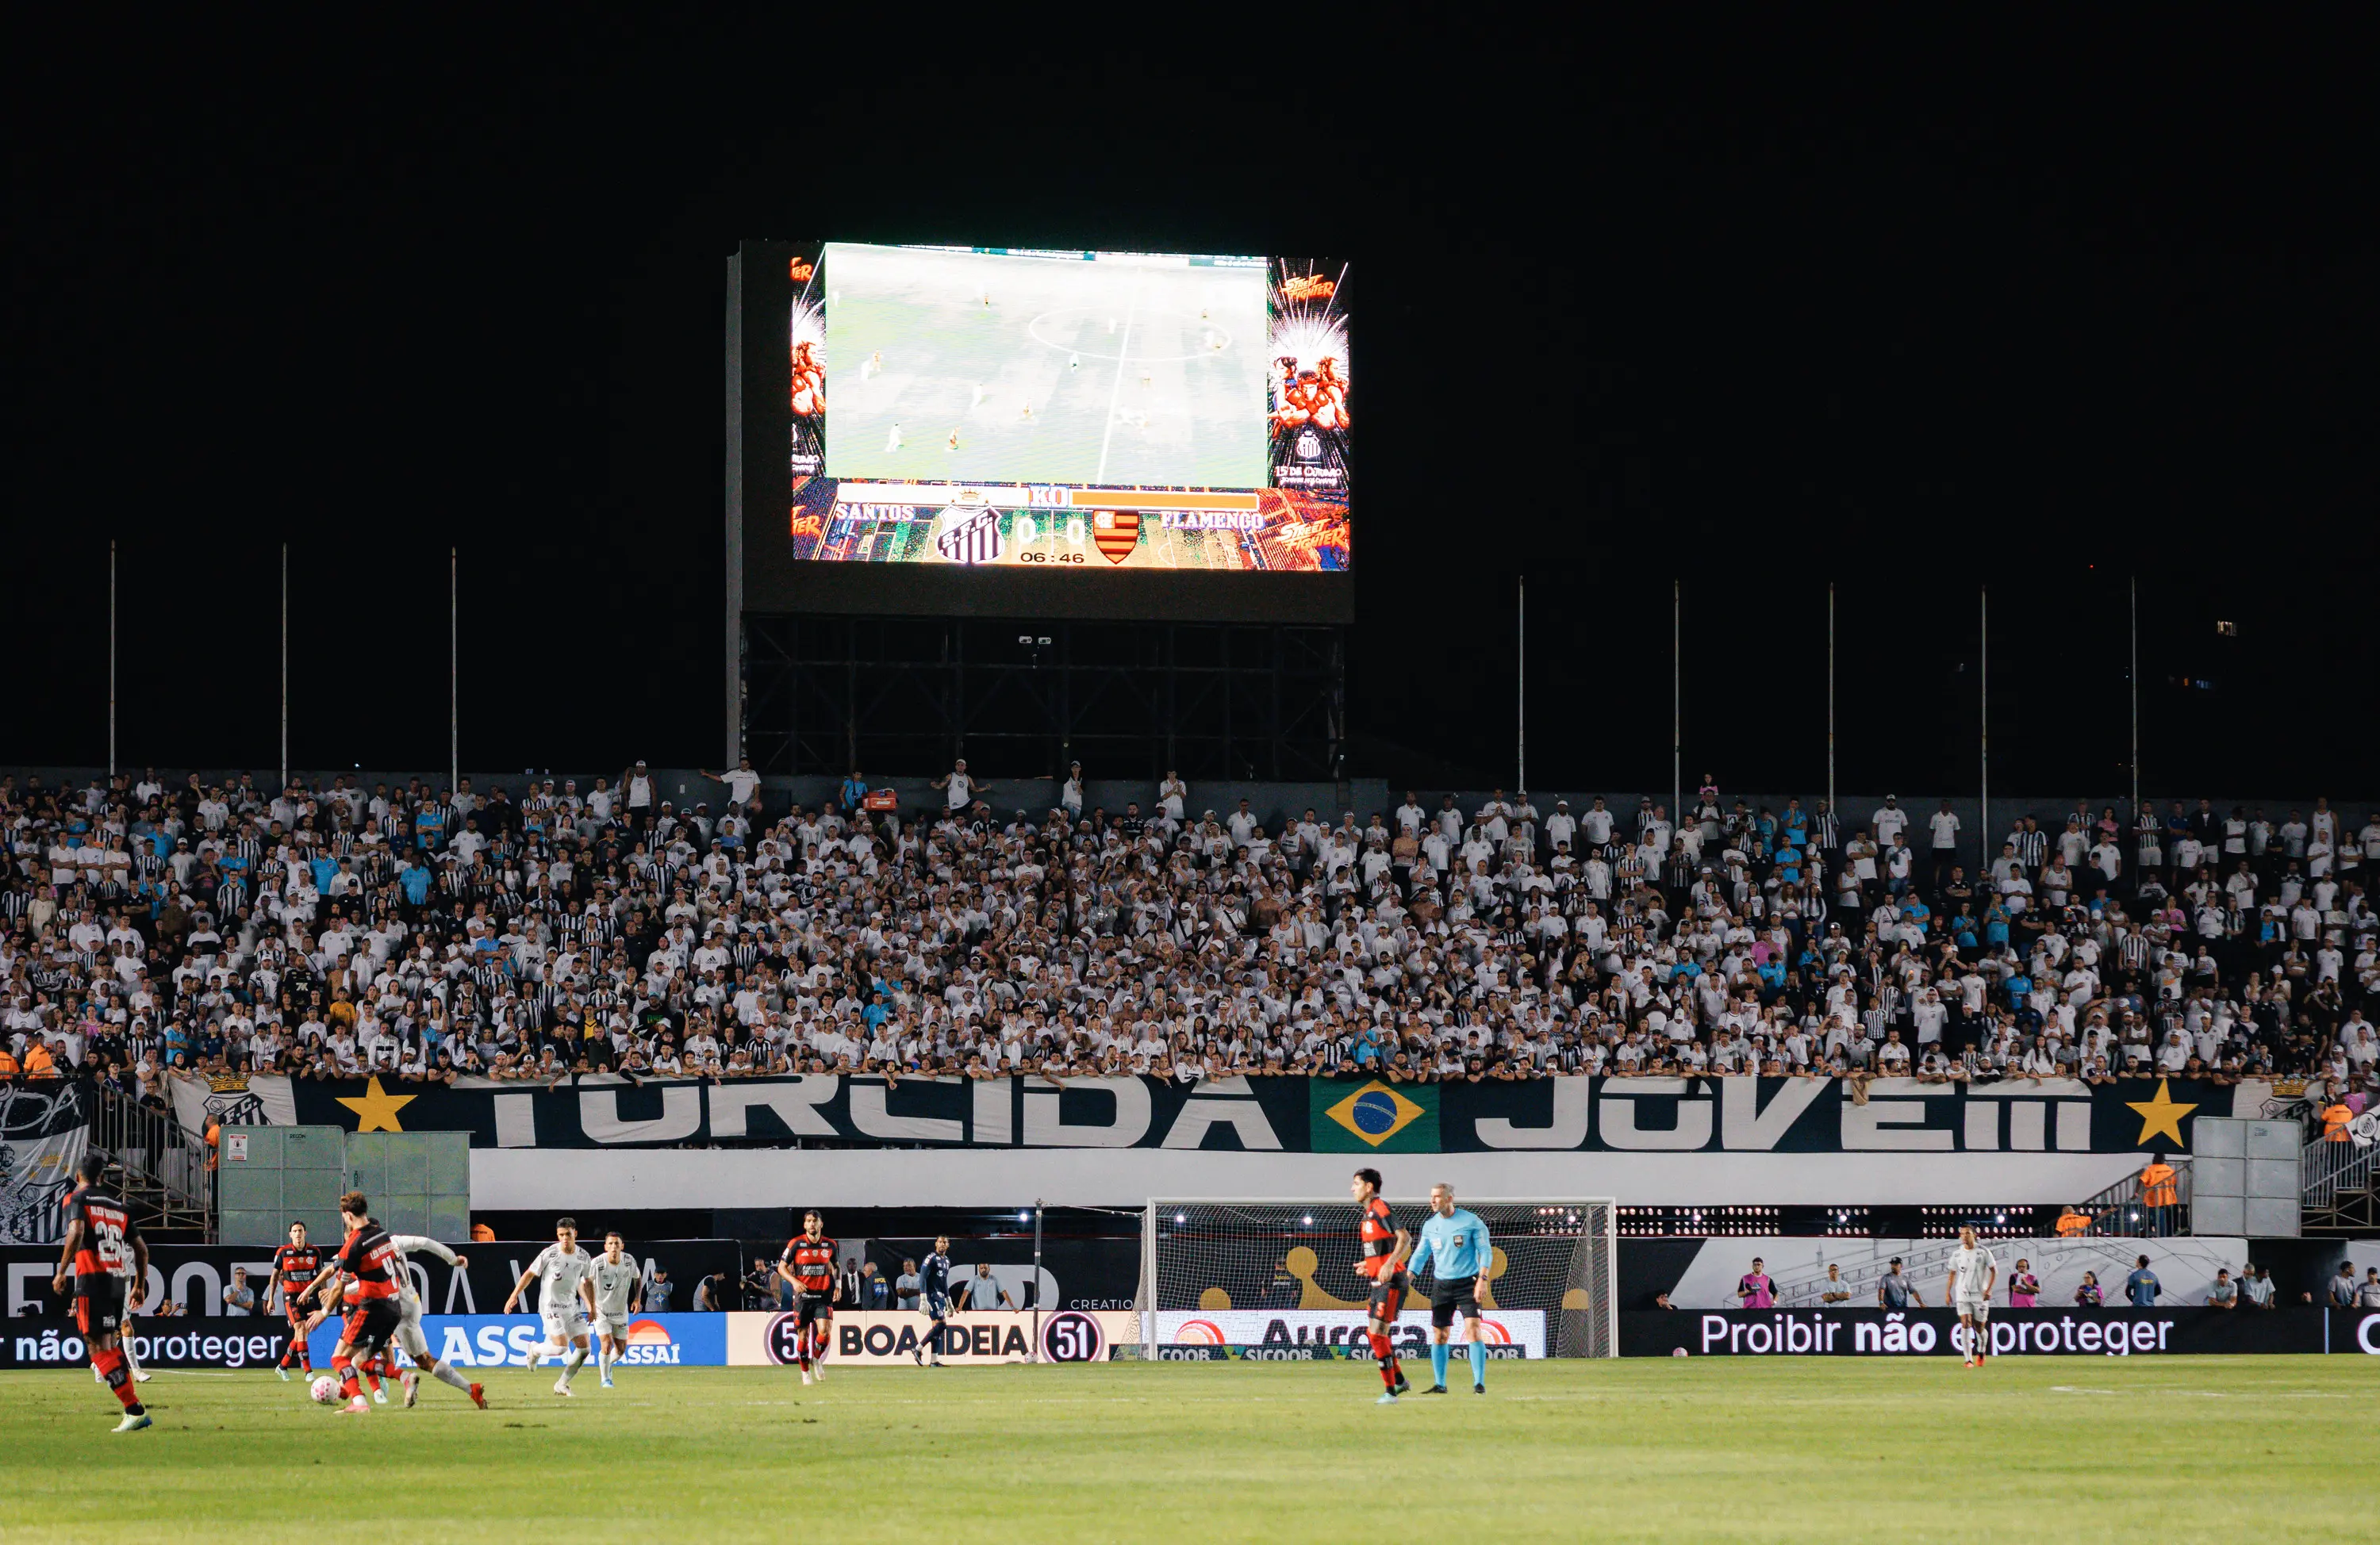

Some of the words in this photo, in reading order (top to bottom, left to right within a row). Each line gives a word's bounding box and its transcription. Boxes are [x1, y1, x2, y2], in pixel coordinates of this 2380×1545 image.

[1280, 274, 1324, 292] STREET
[1290, 282, 1334, 299] FIGHTER
[1276, 466, 1288, 477] 15
[1290, 466, 1302, 476] DE
[1031, 486, 1066, 506] KO
[835, 503, 914, 521] SANTOS
[1161, 512, 1265, 530] FLAMENGO
[1016, 517, 1035, 544] 0
[1066, 518, 1086, 545] 0
[1275, 519, 1332, 540] STREET
[1283, 527, 1346, 553] FIGHTER
[1020, 552, 1084, 563] 06:46
[451, 1073, 1283, 1148] TORCIDA
[1475, 1076, 2091, 1151] JOVEM
[382, 1256, 397, 1289] 4
[839, 1324, 918, 1356] BOA
[1056, 1321, 1088, 1359] 51
[1702, 1314, 1841, 1353] Proibir
[1856, 1313, 1937, 1352] não
[1991, 1316, 2174, 1356] proteger
[16, 1329, 84, 1361] não
[1246, 1349, 1313, 1360] SICOOR
[1351, 1349, 1418, 1359] SICOR
